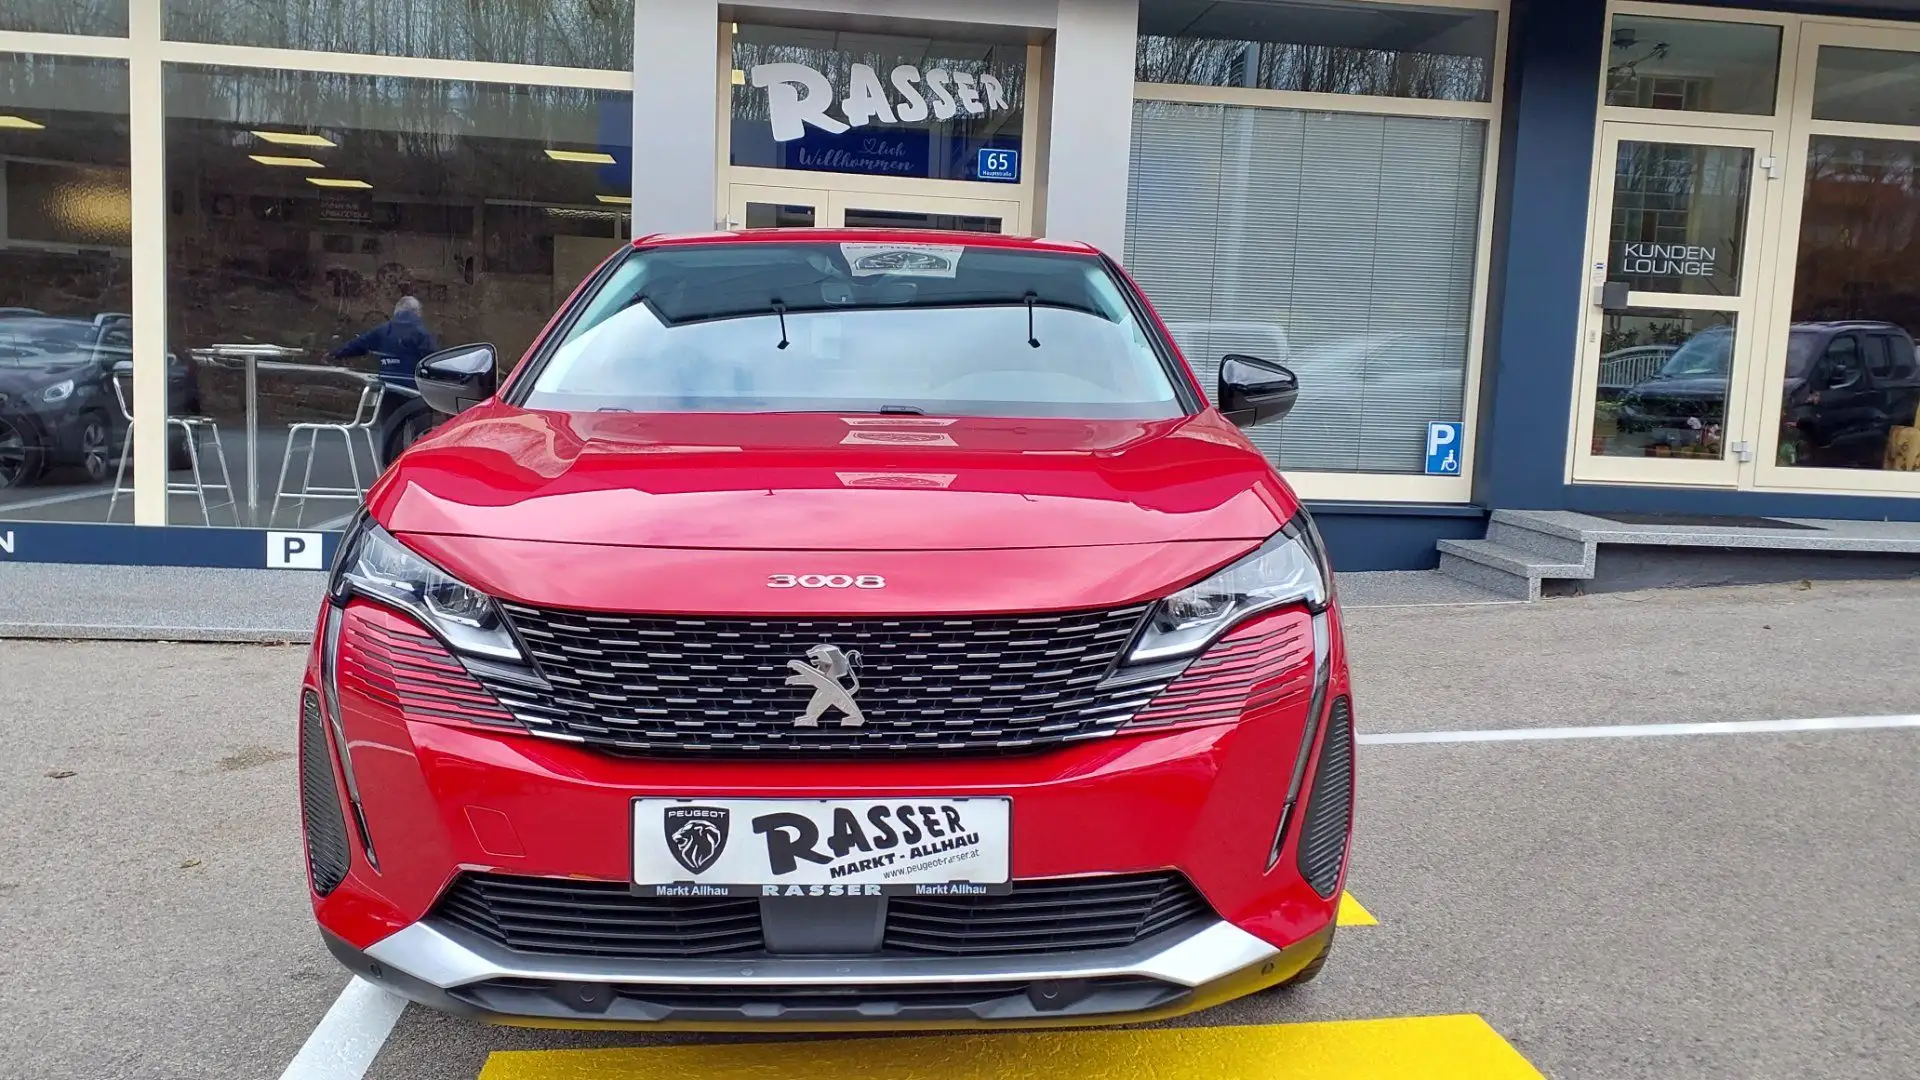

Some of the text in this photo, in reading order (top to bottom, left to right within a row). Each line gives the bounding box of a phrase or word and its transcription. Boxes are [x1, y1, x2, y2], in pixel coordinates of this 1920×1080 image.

[751, 62, 1009, 142] RASSER
[799, 147, 915, 171] Willkommen
[987, 153, 1008, 170] 65
[1624, 243, 1716, 260] KUNDEN
[1623, 258, 1715, 276] LOUNGE
[1430, 424, 1455, 456] P
[284, 537, 305, 564] P
[766, 574, 886, 589] 3008
[668, 810, 727, 819] PEUGEOT
[752, 805, 966, 876] RASSER
[829, 852, 896, 879] MARKT
[909, 832, 980, 860] ALLHAU
[656, 885, 729, 896] Markt Allhau
[762, 884, 882, 897] RASSER
[915, 885, 987, 895] Markt Allhau
